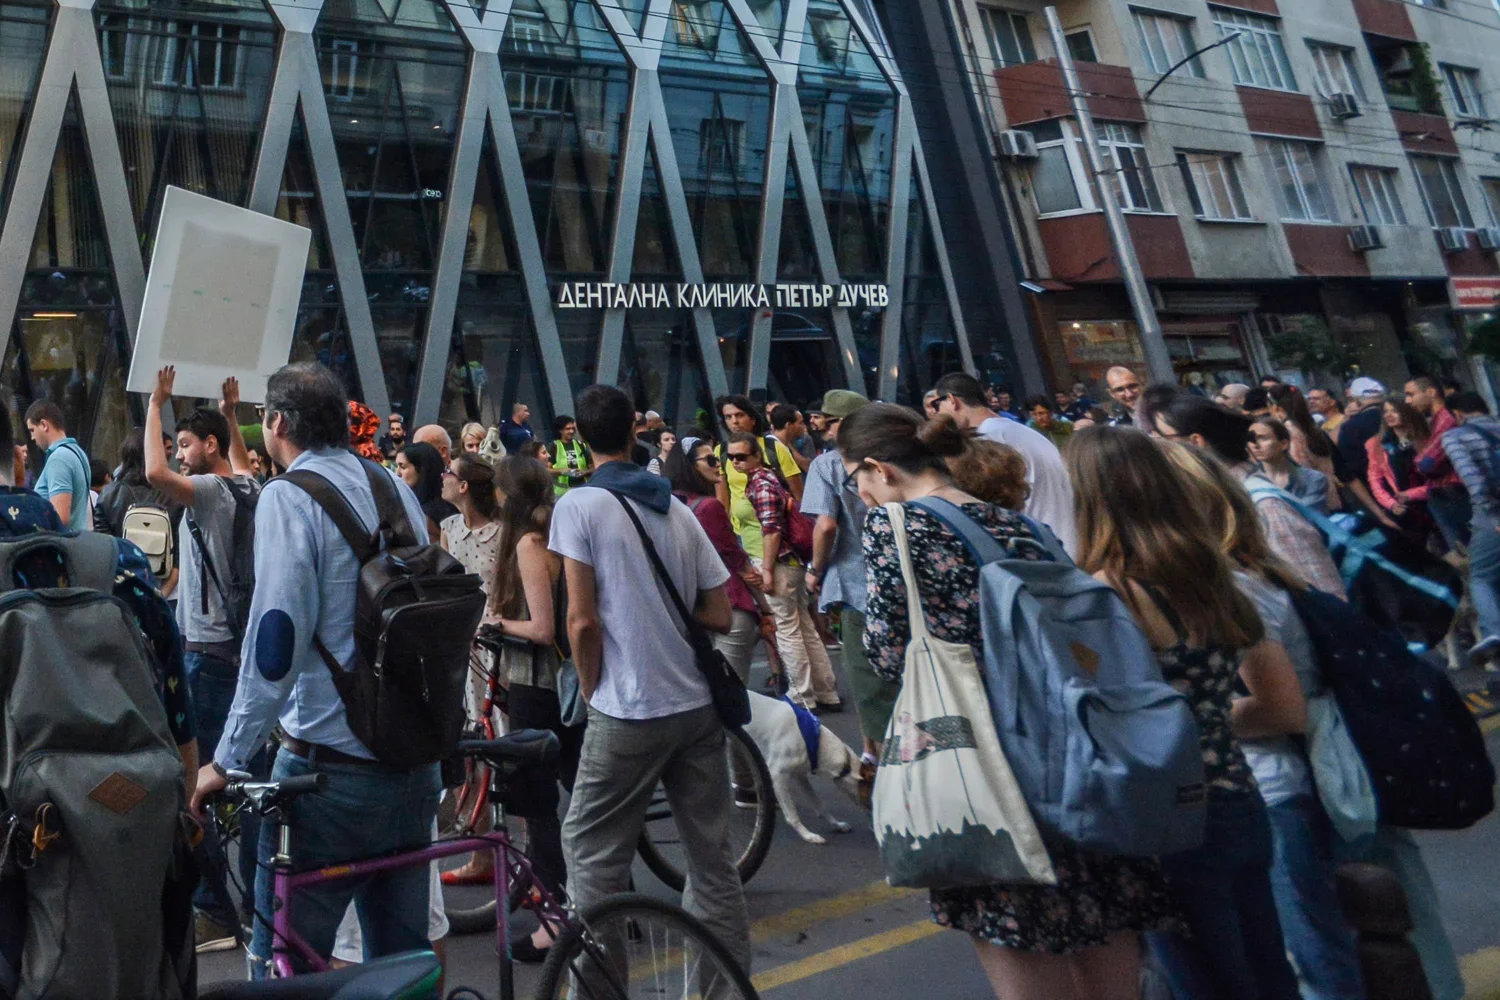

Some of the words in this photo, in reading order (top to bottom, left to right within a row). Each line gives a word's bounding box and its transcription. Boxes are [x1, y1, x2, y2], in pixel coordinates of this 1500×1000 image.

[558, 282, 671, 308] ДЕНТАЛНА
[677, 283, 770, 308] КЛИНИКА
[775, 283, 833, 308] ПЕТЪР
[837, 284, 889, 308] ДУЧЕВ
